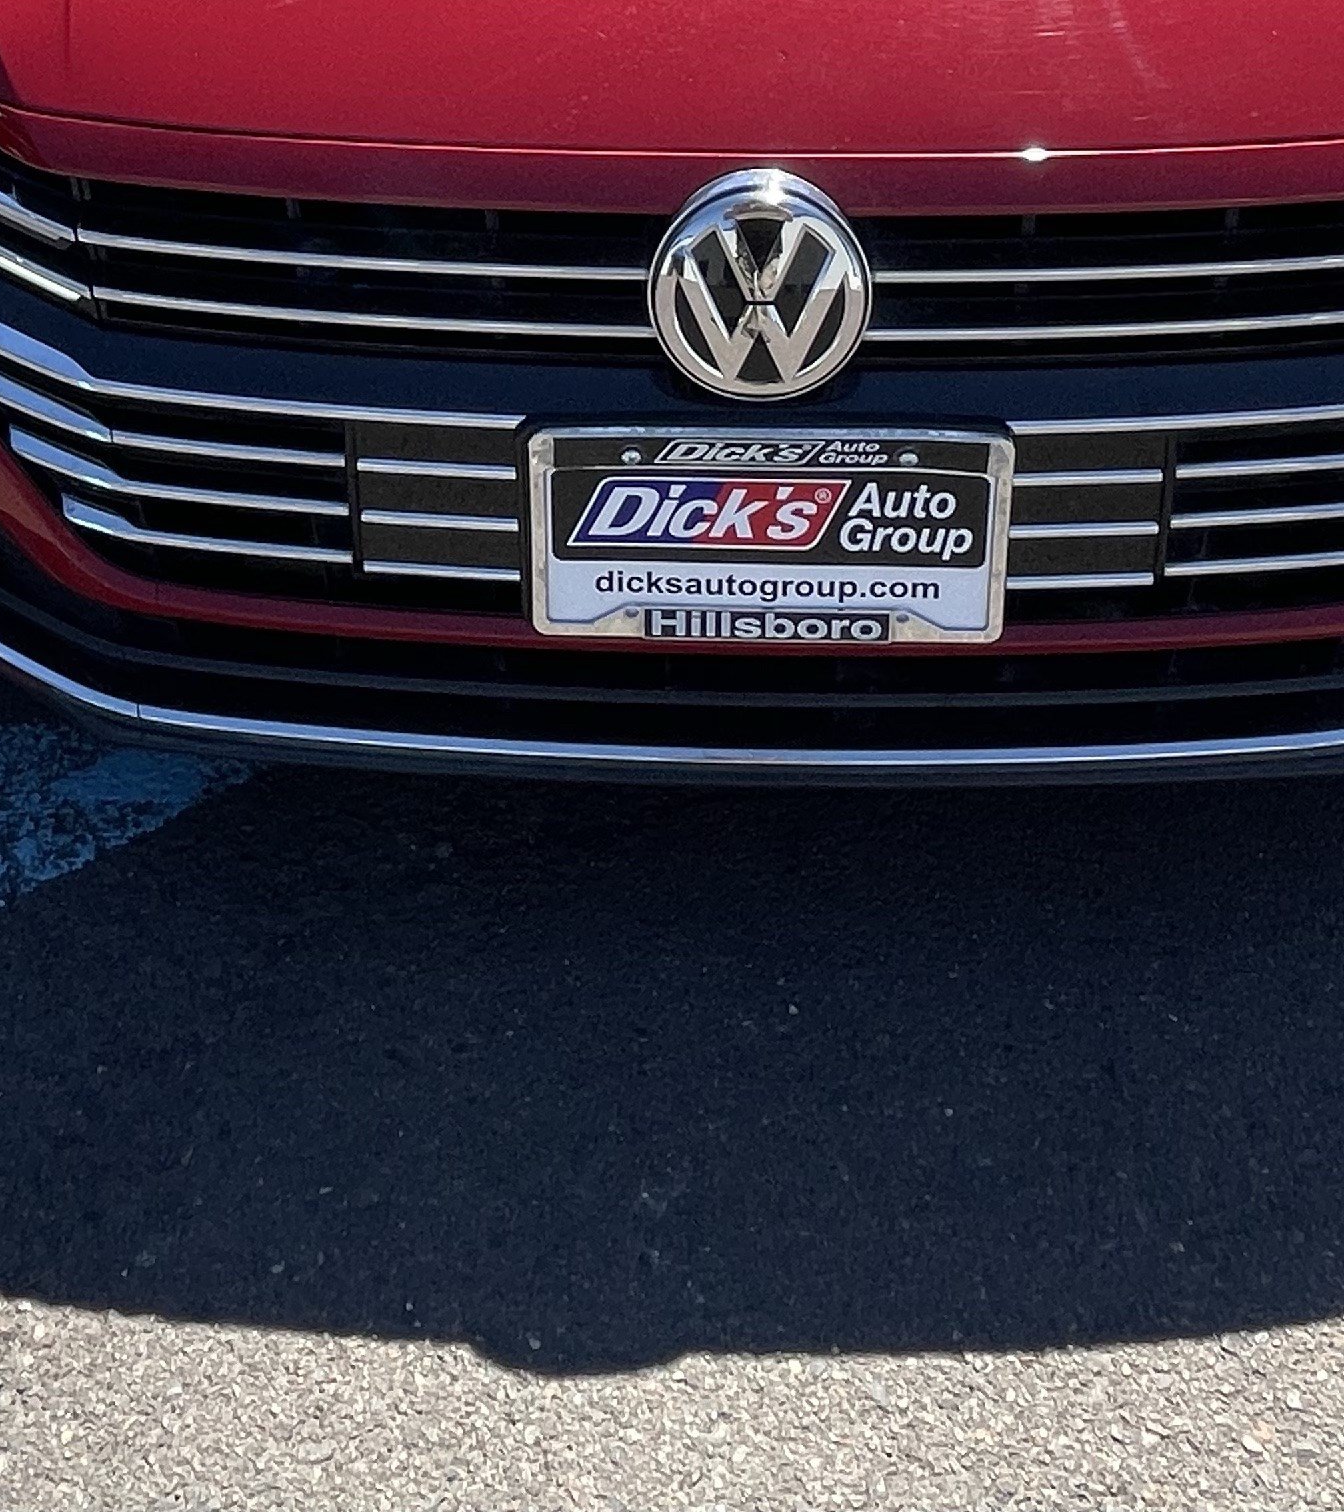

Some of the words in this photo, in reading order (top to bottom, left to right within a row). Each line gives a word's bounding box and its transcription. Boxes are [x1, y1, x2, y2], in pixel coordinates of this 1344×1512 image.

[818, 452, 888, 465] Group
[826, 441, 880, 453] Auto
[847, 482, 957, 520] Auto
[839, 519, 973, 561] Group
[594, 570, 940, 602] dicksautogroup.com
[652, 610, 883, 641] Hillsboro
